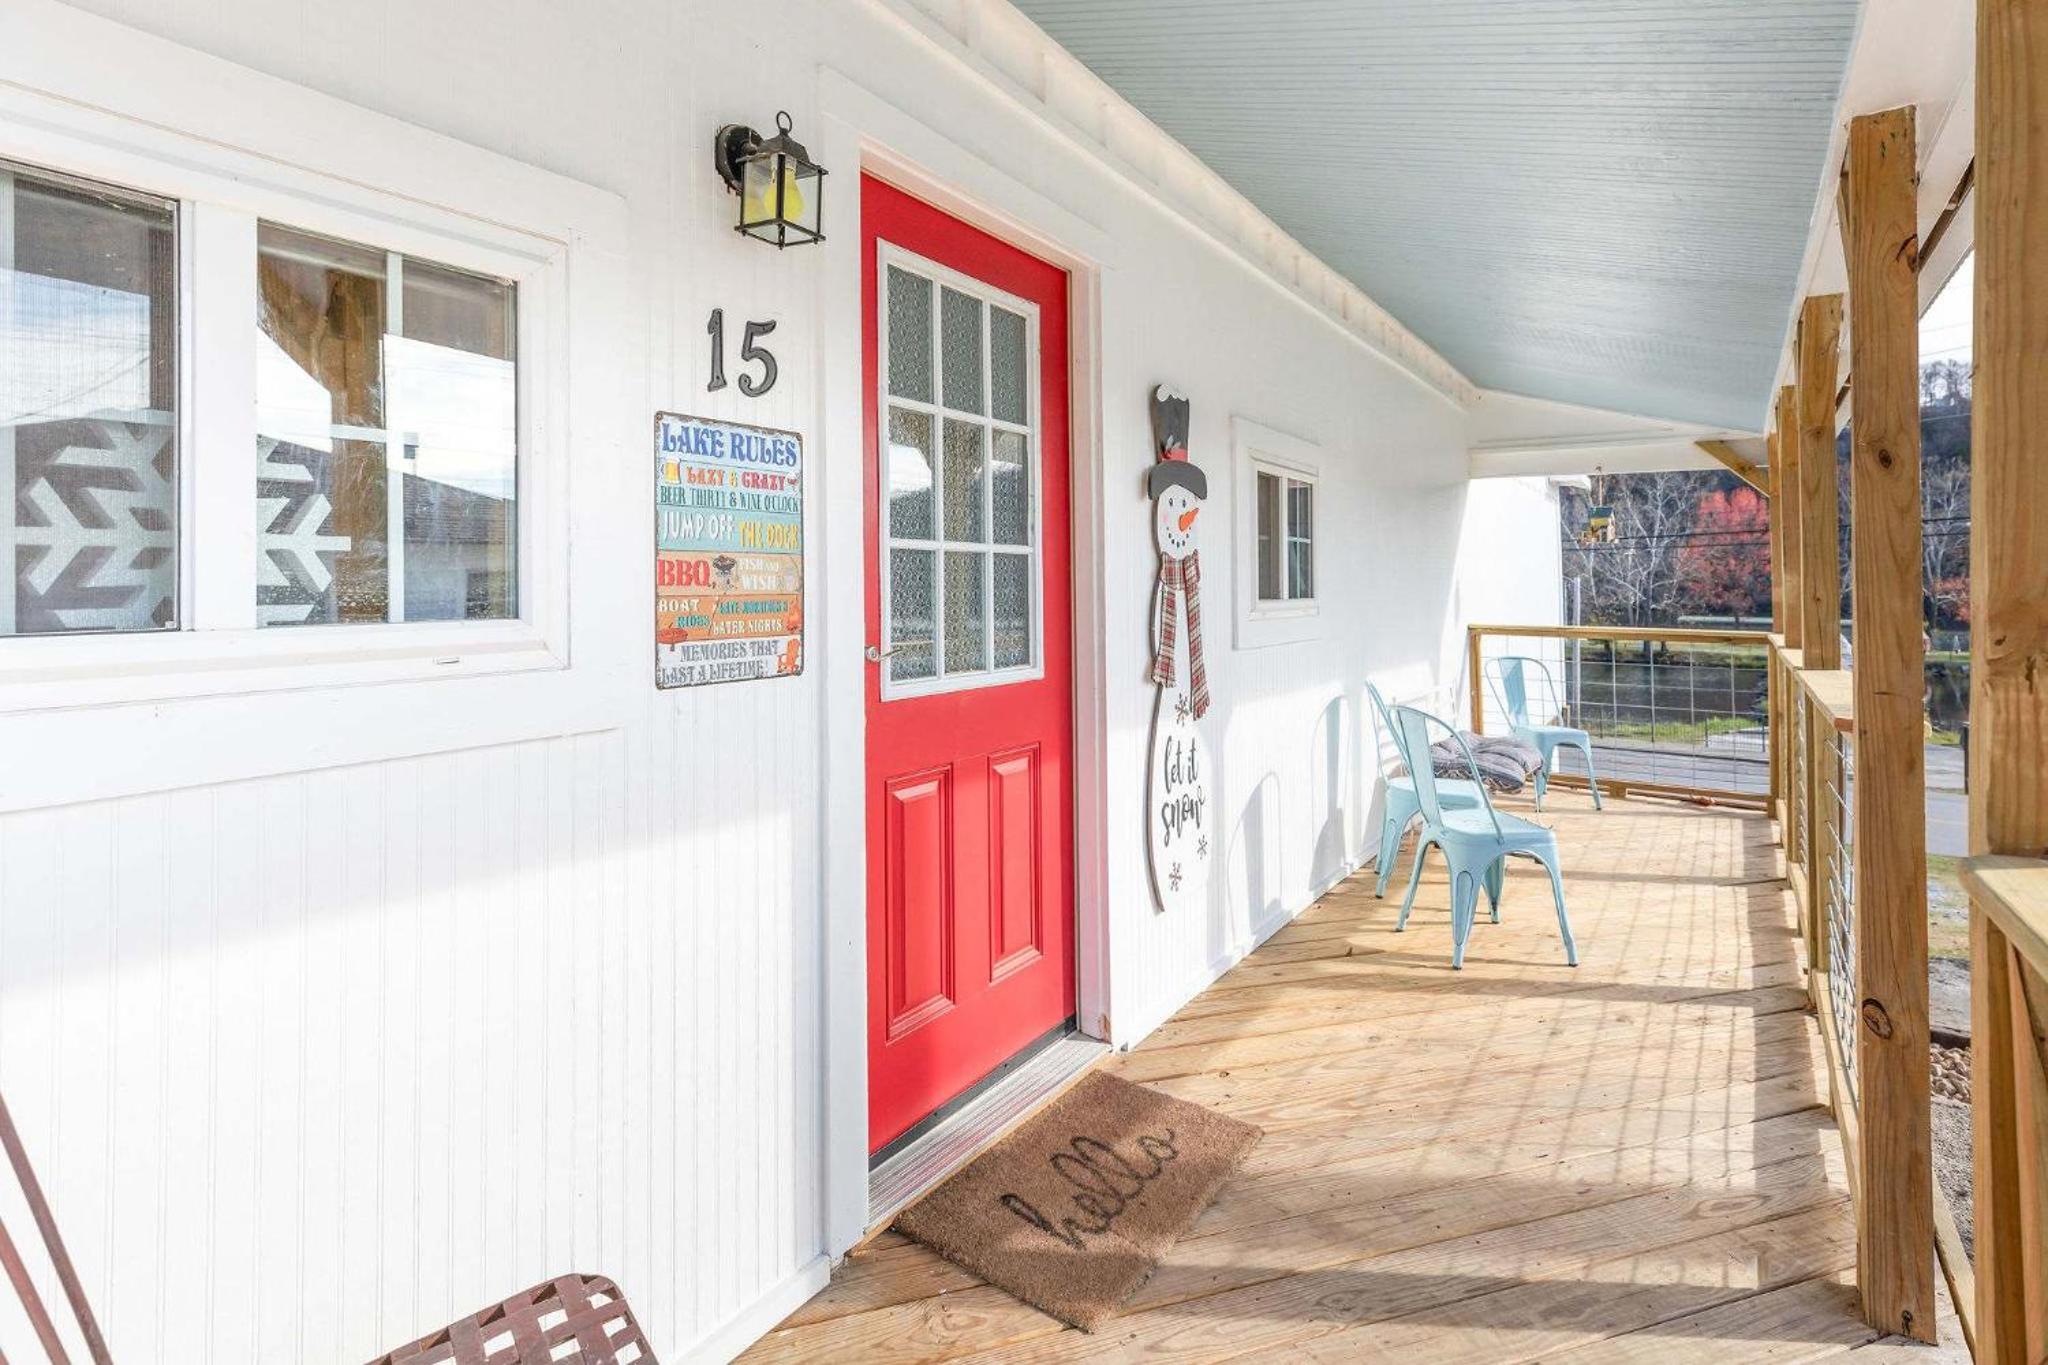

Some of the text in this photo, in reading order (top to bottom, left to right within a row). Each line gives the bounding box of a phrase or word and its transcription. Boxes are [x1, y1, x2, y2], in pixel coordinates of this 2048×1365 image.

[707, 308, 778, 397] 15
[662, 423, 797, 467] LAKE RULES
[686, 467, 786, 491] LAZY & CRAZY
[660, 486, 686, 505] BEER
[690, 488, 726, 507] THIRTY
[729, 492, 738, 507] &
[740, 493, 761, 510] WINE
[664, 511, 800, 549] JUMP OFF THE DOCK
[739, 559, 765, 571] FISH
[742, 575, 776, 591] WISH
[658, 599, 700, 612] BOAT
[713, 618, 782, 634] LATER NIGHTS
[680, 640, 780, 662] MEMORIES THAT
[662, 665, 698, 684] LAST
[697, 663, 706, 681] A
[1187, 737, 1200, 785] it
[1161, 785, 1205, 848] snow
[1000, 1128, 1179, 1251] hello
